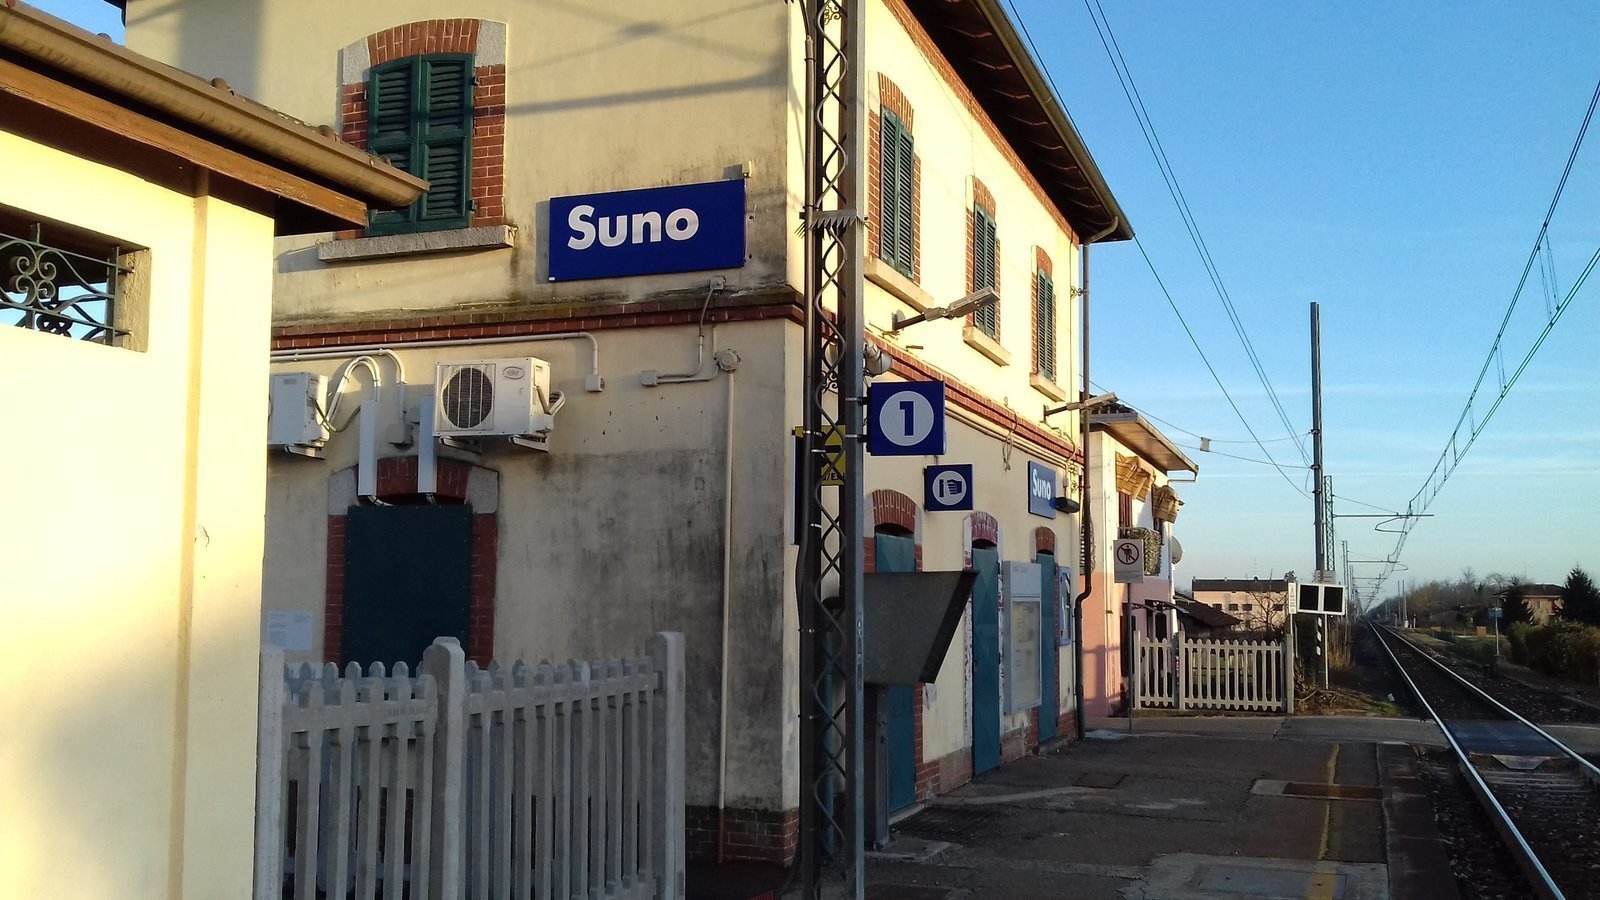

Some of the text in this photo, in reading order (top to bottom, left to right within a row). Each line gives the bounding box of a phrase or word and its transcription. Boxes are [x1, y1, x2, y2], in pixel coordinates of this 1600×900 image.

[567, 204, 699, 250] Suno
[899, 400, 914, 437] 1
[1032, 468, 1052, 500] Suno
